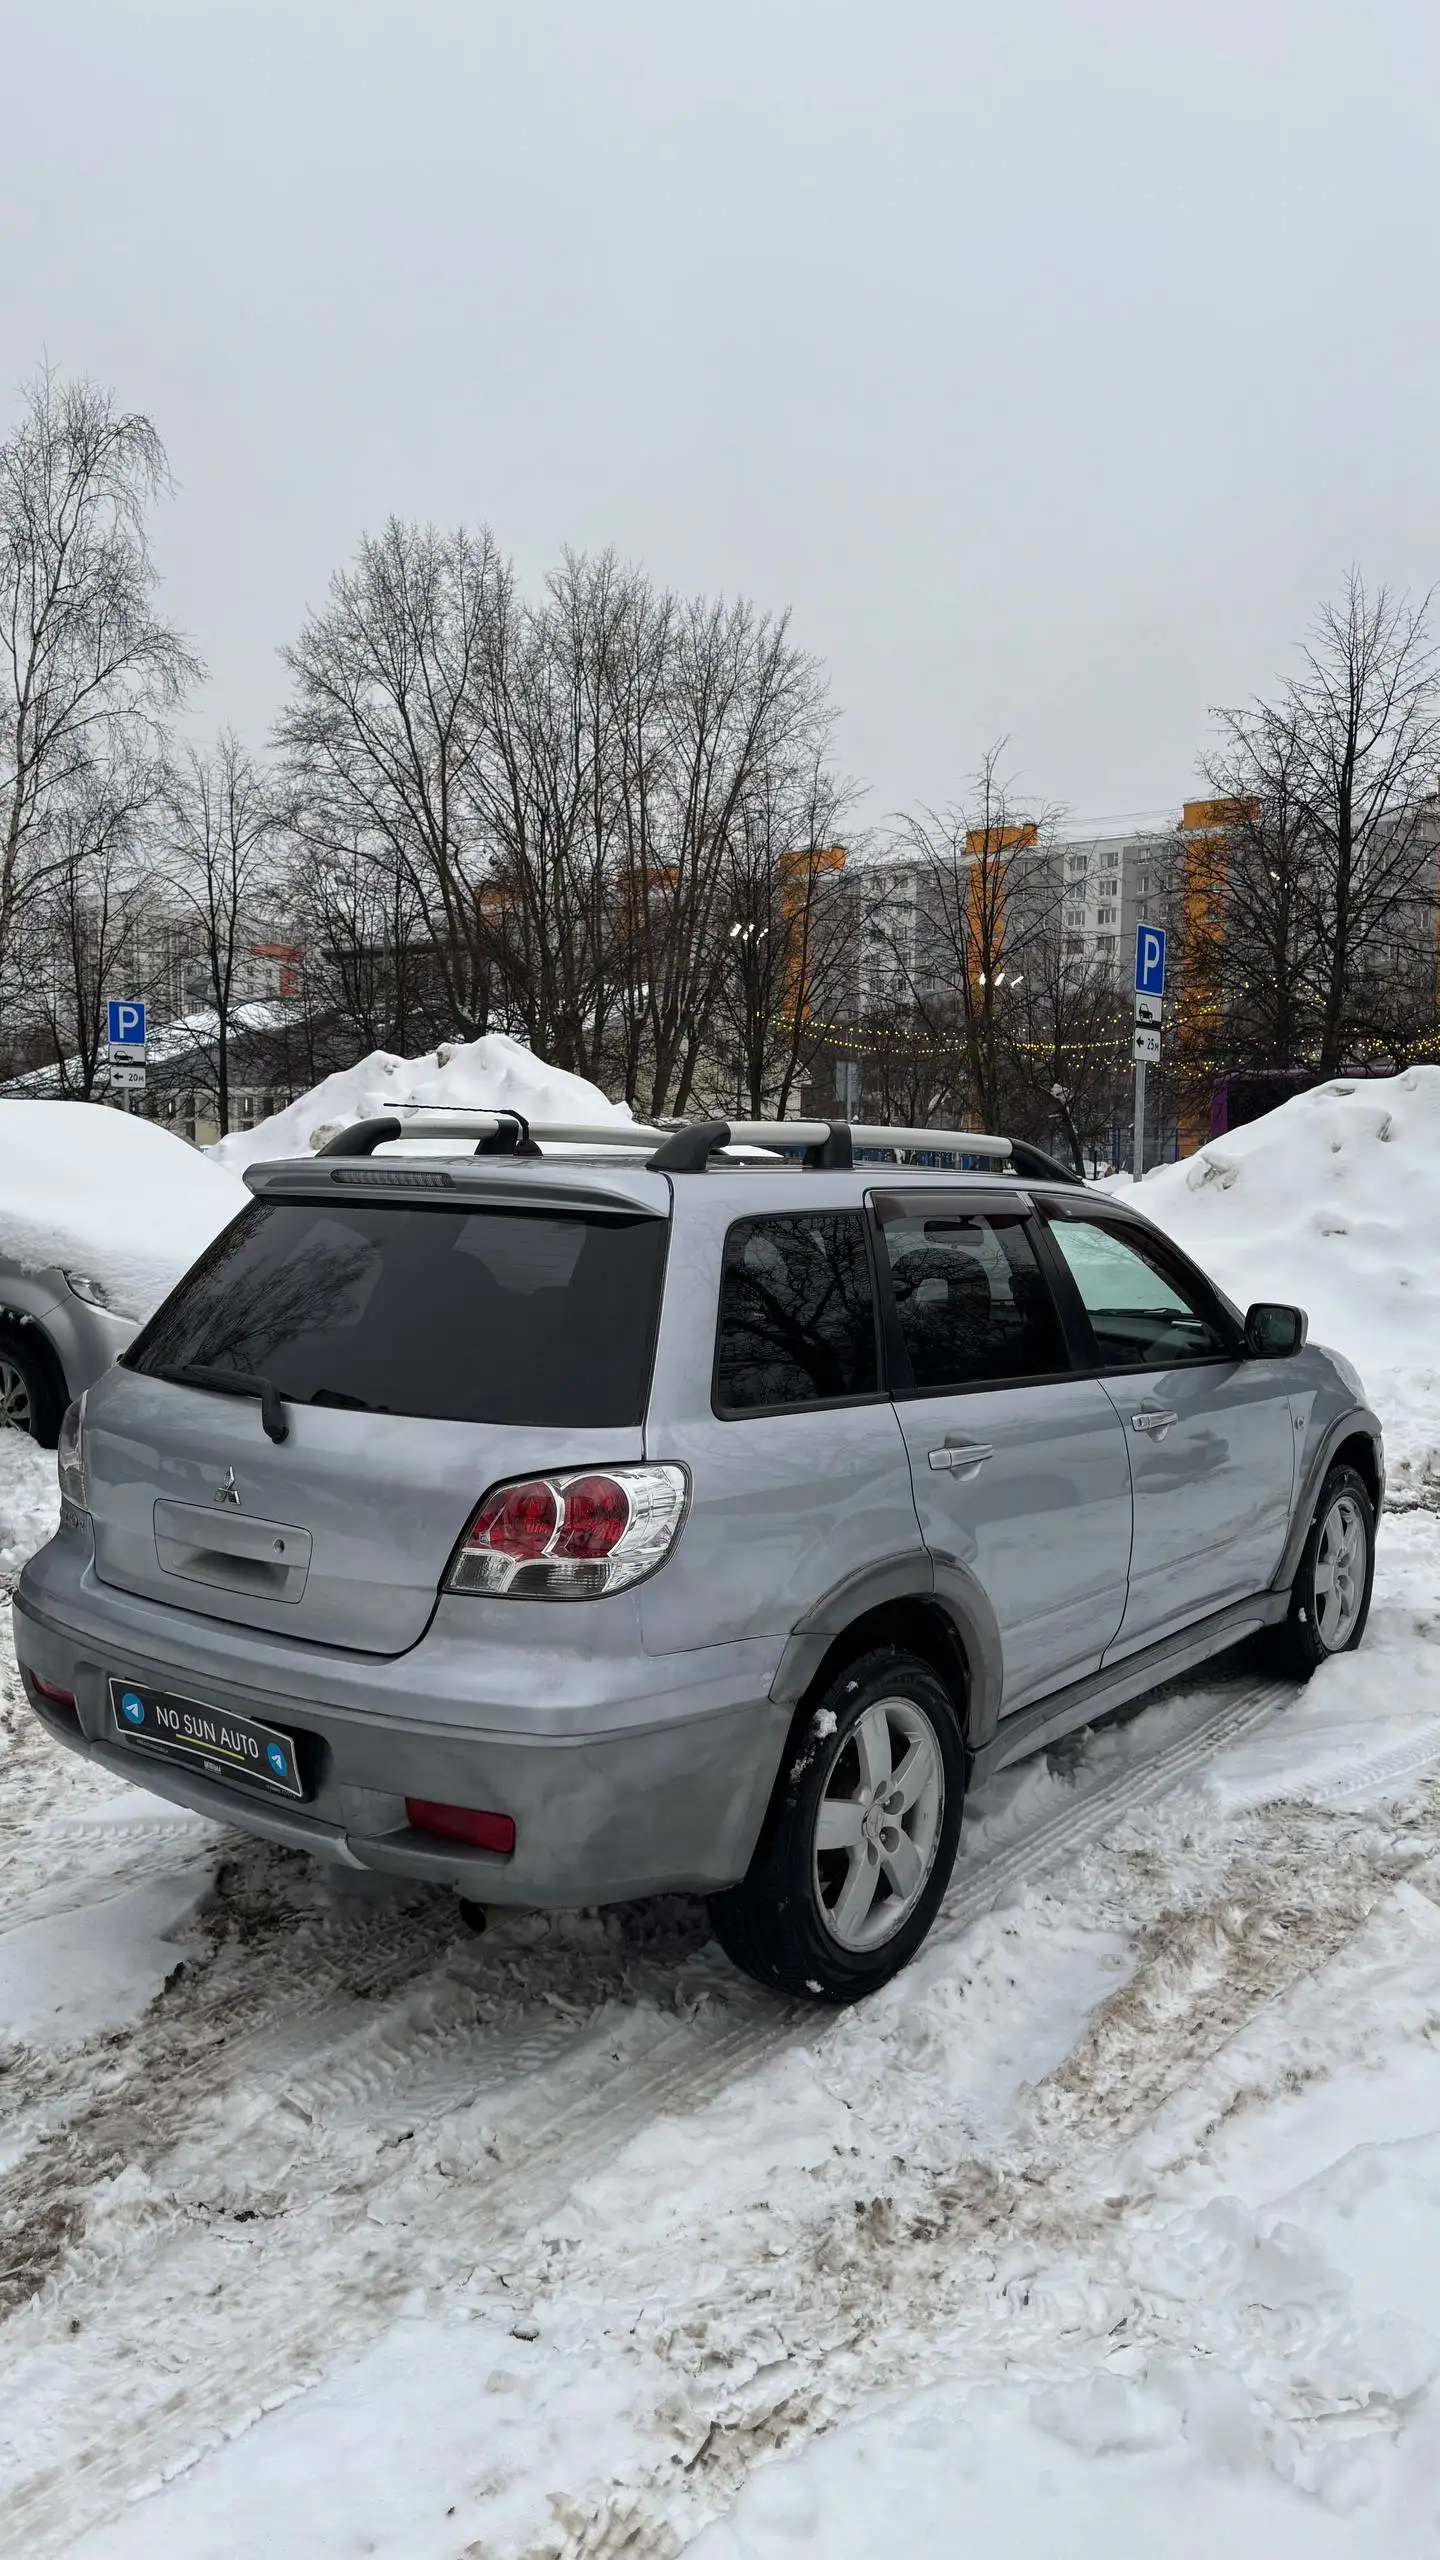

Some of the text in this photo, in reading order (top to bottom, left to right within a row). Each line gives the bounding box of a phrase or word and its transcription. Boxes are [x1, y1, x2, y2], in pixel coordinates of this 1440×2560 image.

[1143, 933, 1160, 985] P
[118, 1006, 139, 1039] P
[156, 1706, 259, 1758] NO SUN AUTO
